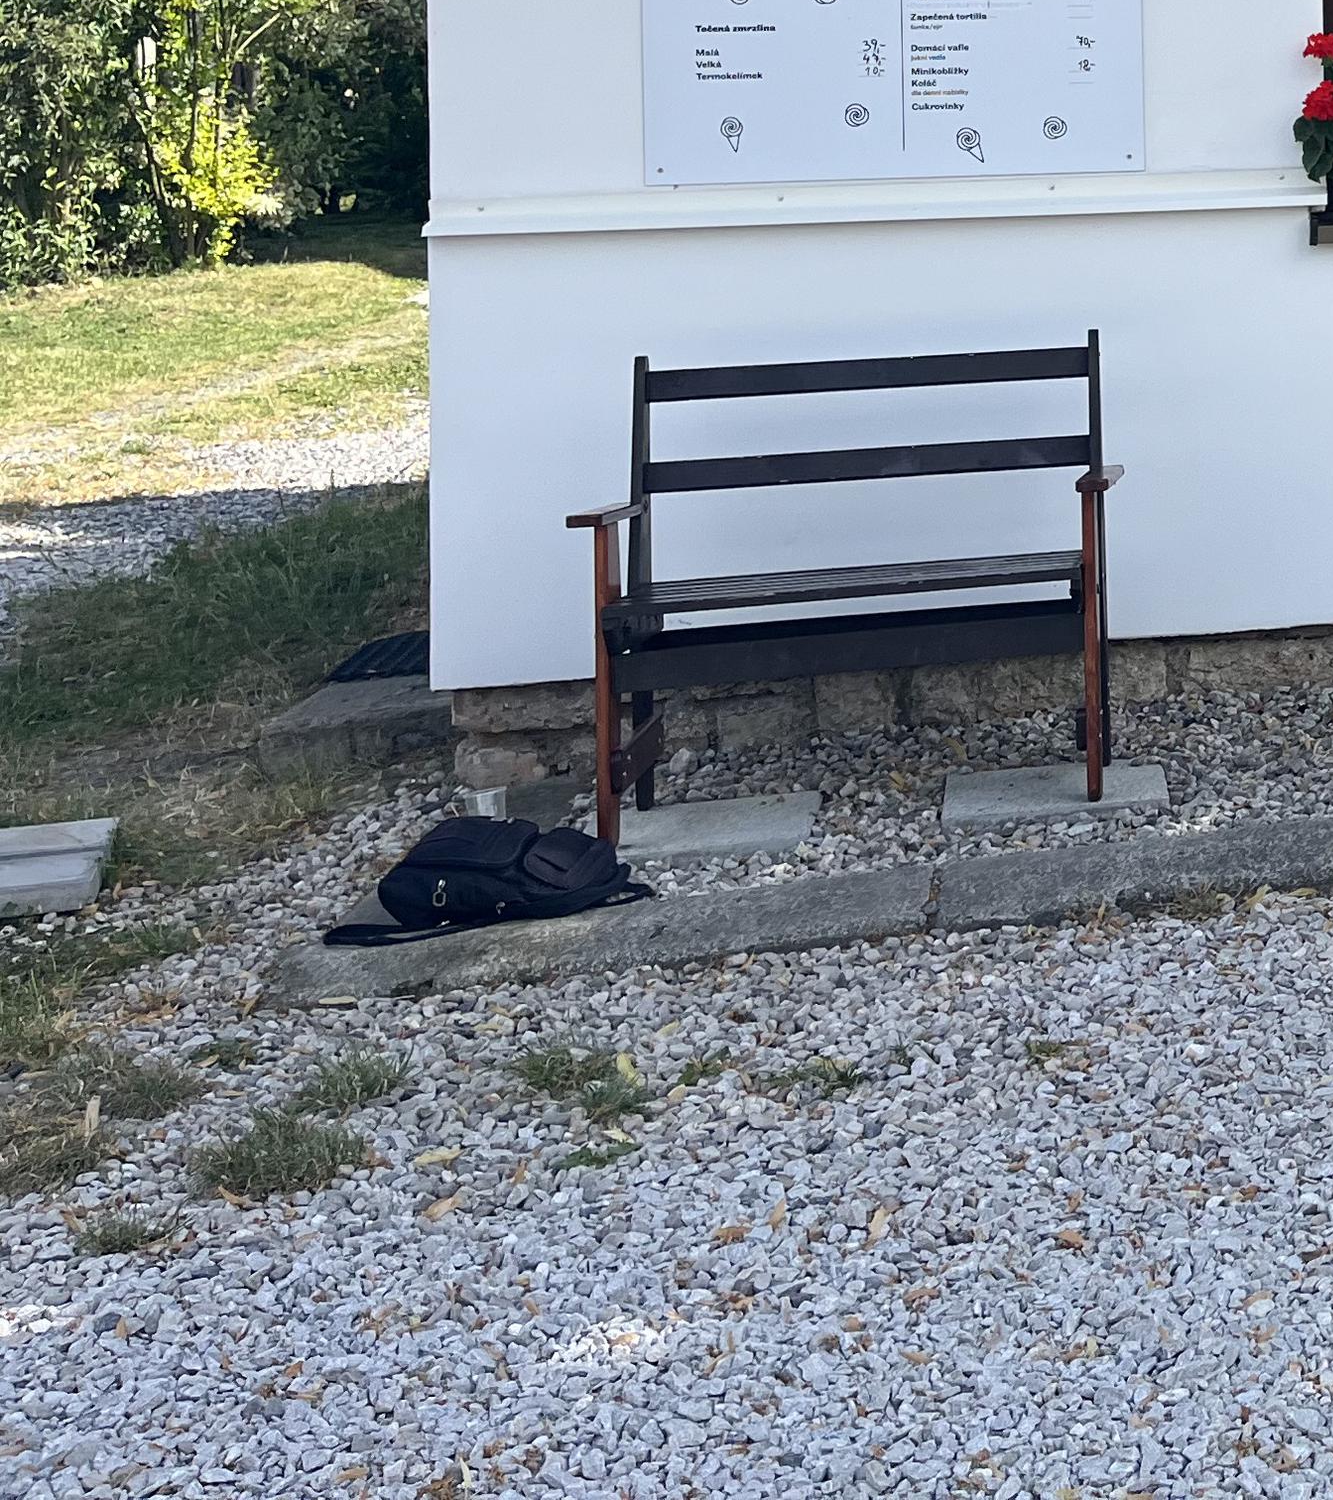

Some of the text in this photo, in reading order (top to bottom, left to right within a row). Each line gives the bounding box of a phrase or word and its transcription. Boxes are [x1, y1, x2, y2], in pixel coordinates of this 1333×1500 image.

[910, 14, 954, 22] Zapečená
[911, 44, 945, 52] Domácí
[911, 68, 969, 76] Minikobližky
[912, 103, 964, 111] Cukrovinky
